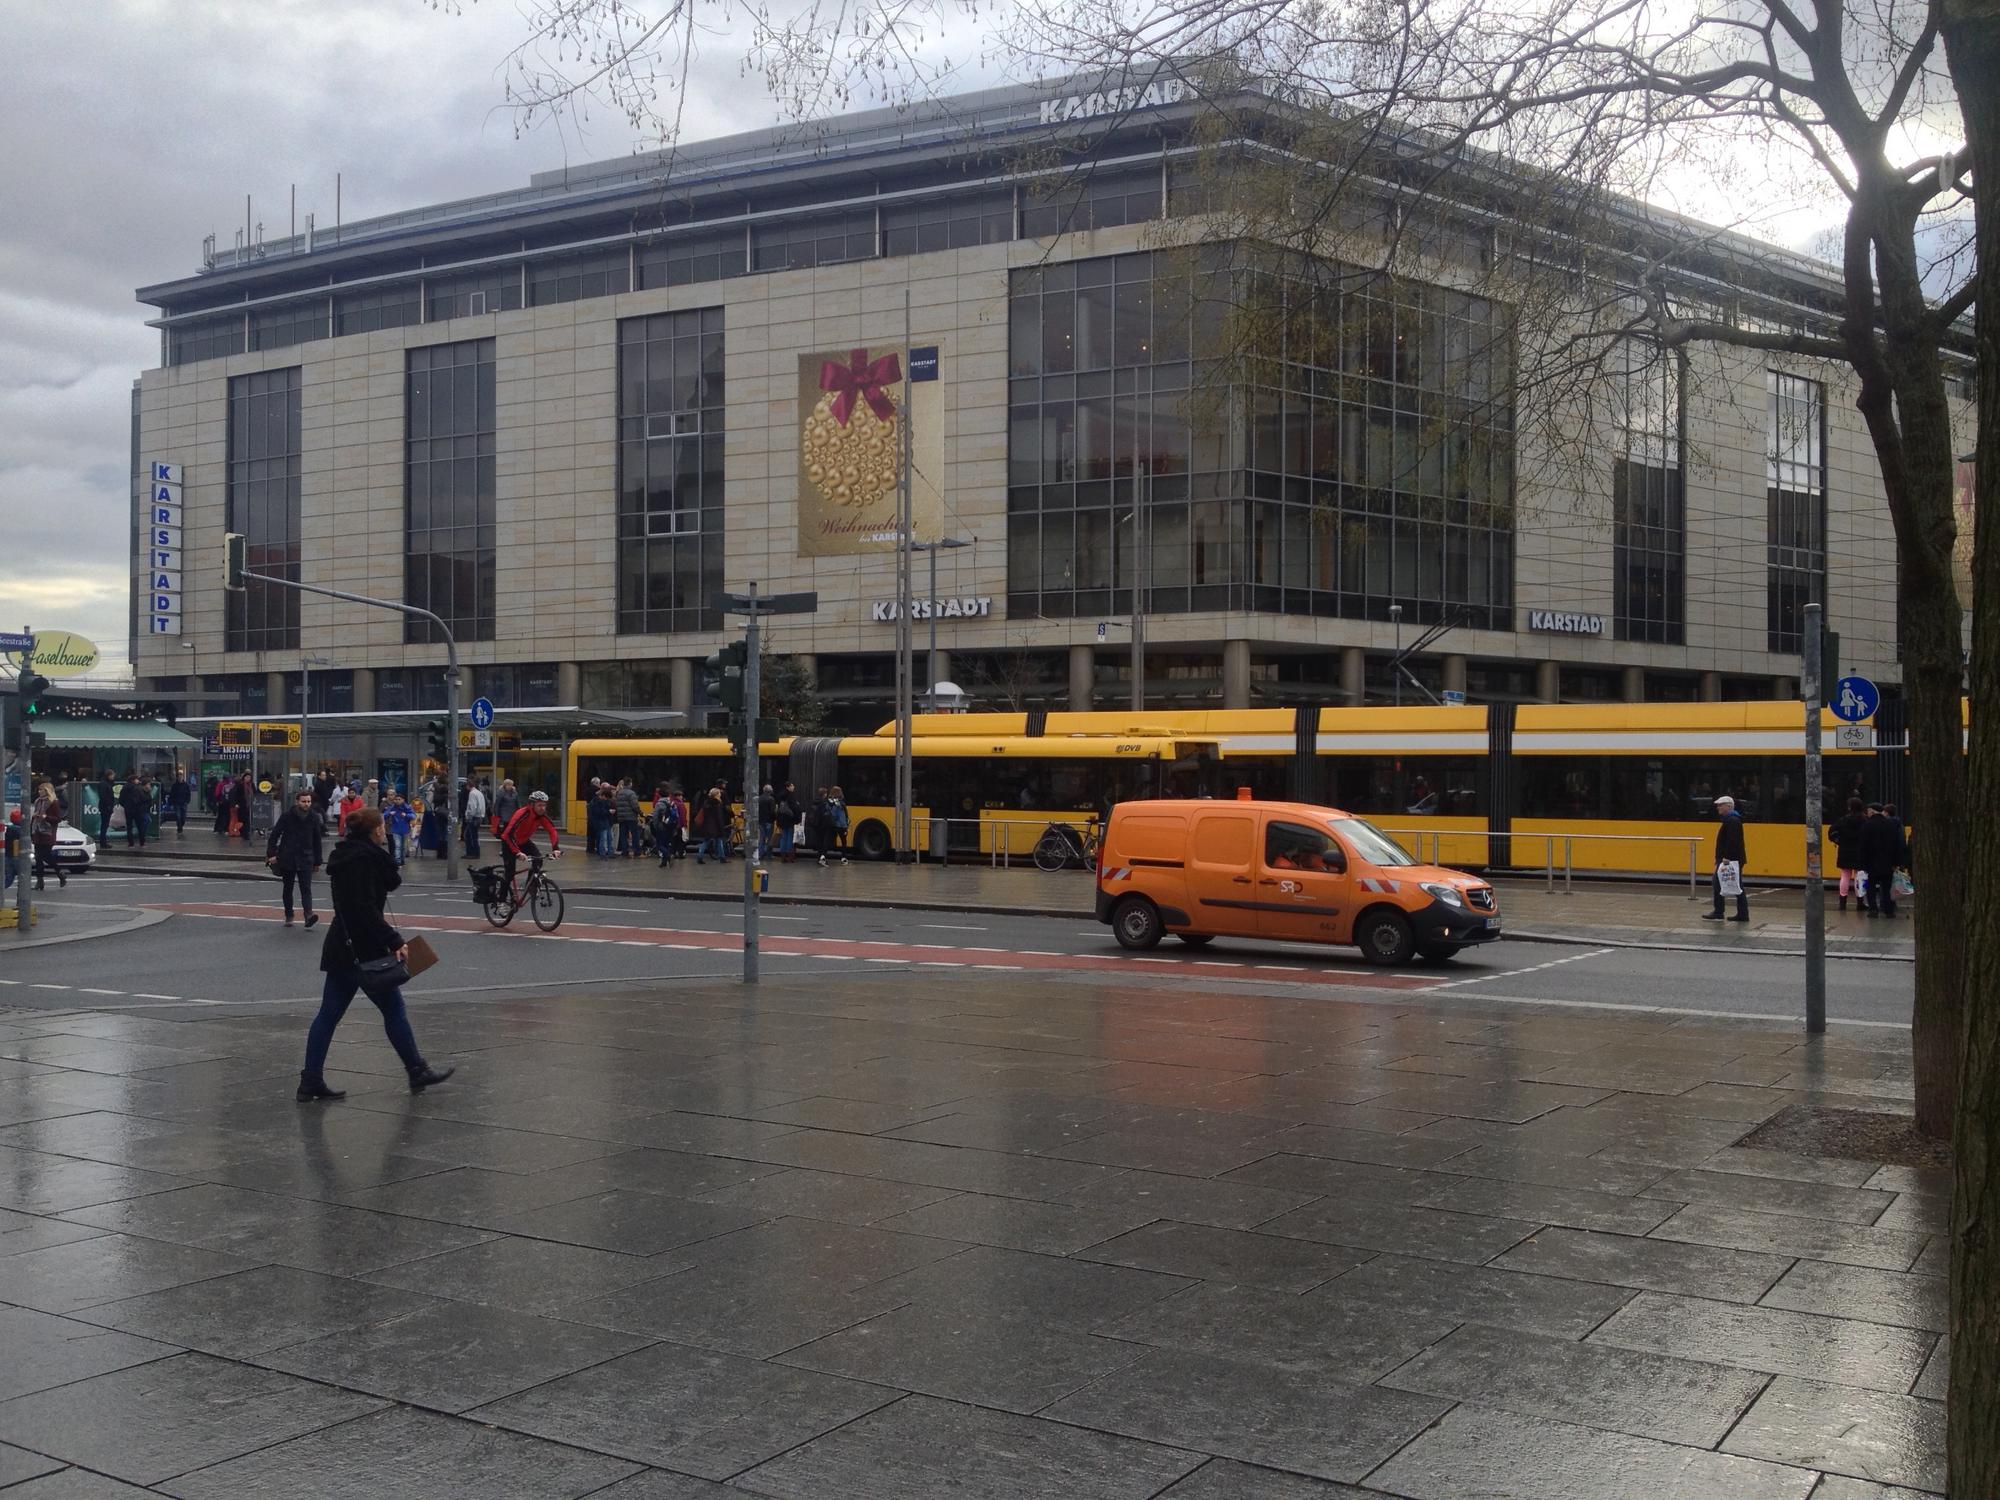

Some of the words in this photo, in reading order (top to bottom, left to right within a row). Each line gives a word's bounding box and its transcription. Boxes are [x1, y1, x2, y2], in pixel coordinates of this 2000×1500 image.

[821, 512, 918, 534] Weihnachn
[157, 465, 171, 632] KARSTADT
[872, 598, 991, 620] KARSTADT
[1532, 611, 1607, 633] KARSTADT
